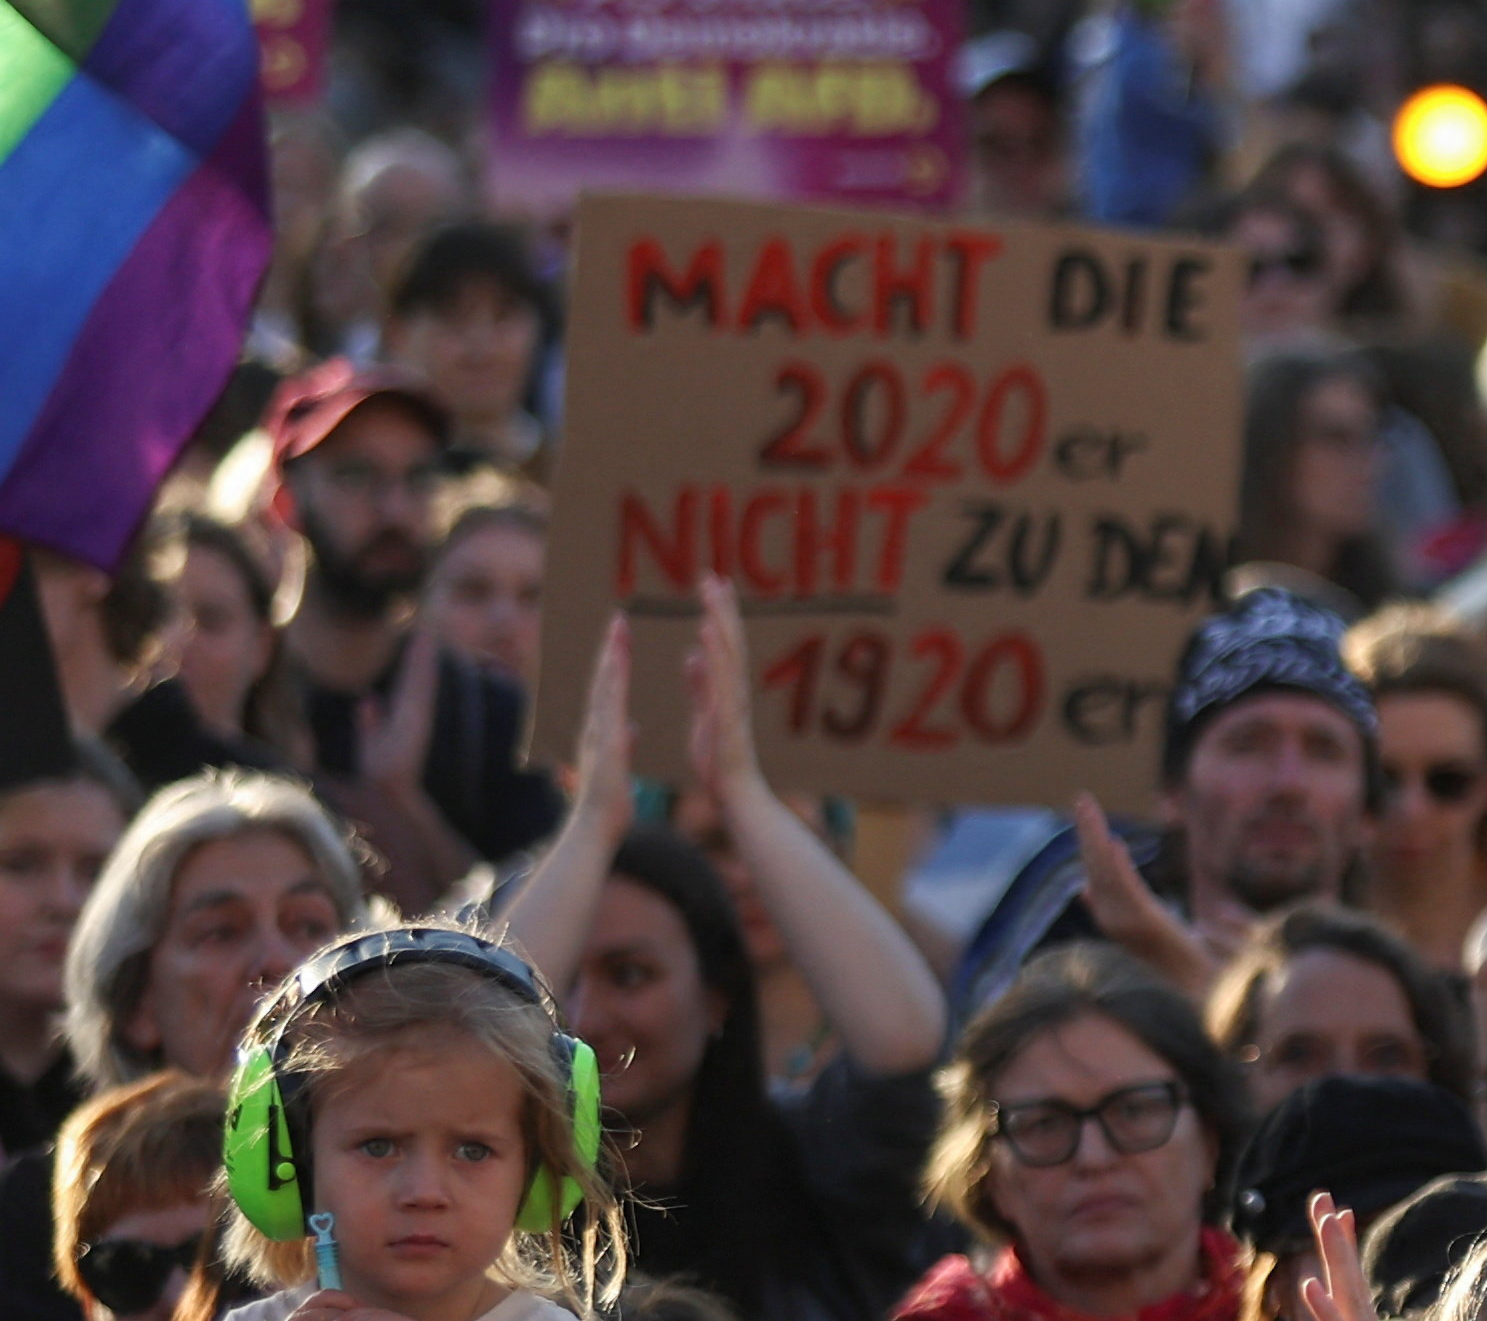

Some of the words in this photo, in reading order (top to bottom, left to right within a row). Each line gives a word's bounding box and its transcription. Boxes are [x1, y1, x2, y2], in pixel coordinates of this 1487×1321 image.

[626, 229, 1003, 339] MACHT
[1050, 249, 1210, 341] DIE
[616, 484, 934, 598] NICHT
[941, 500, 1062, 593] ZU
[1086, 518, 1238, 607] DEN
